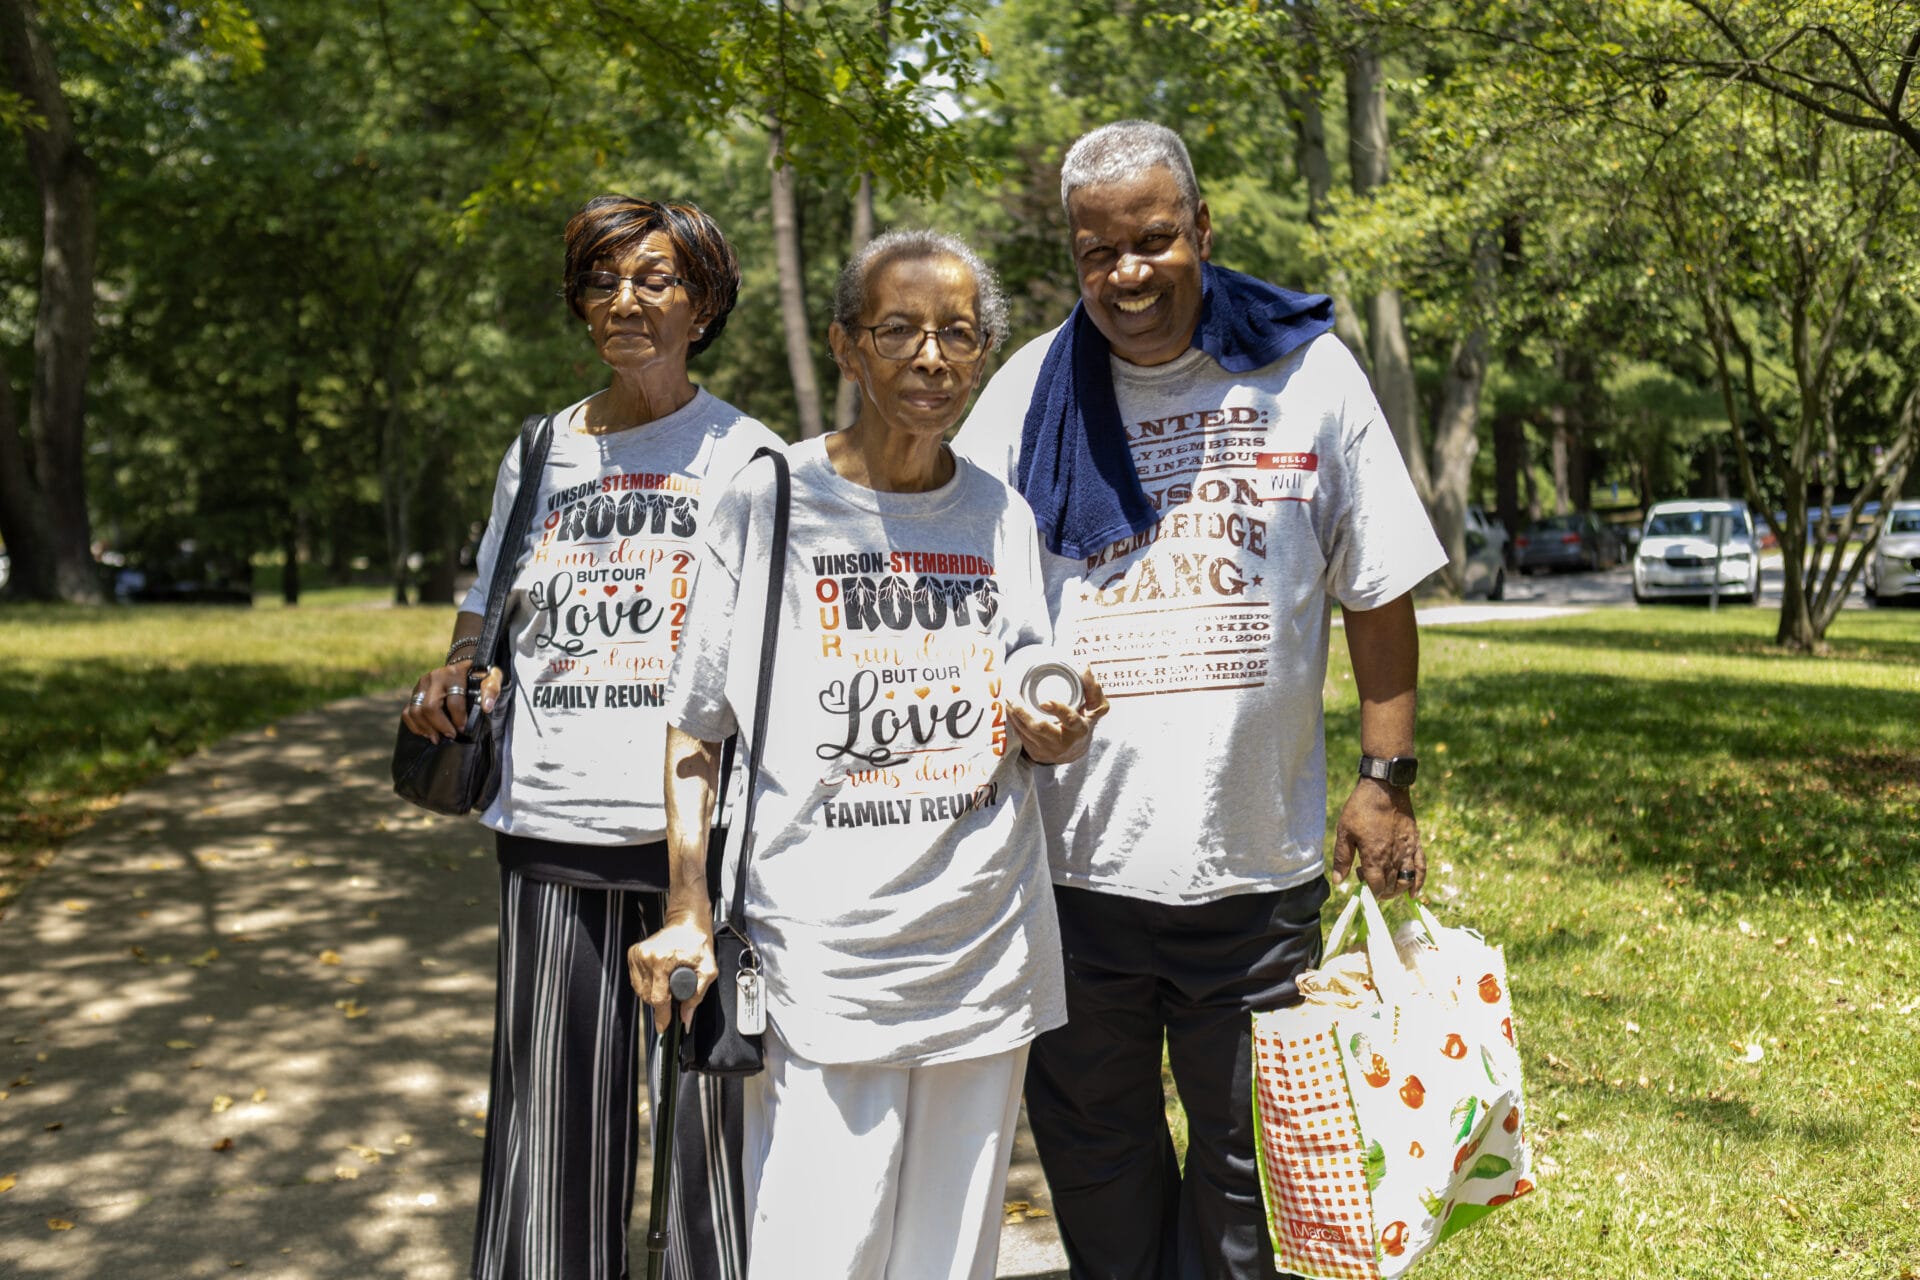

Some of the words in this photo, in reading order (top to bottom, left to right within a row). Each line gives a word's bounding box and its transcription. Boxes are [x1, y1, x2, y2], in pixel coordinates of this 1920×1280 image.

[1158, 437, 1266, 459] MEMBERS
[1272, 456, 1307, 464] HELLO
[1142, 478, 1263, 512] NSON
[1272, 473, 1302, 491] Will
[557, 491, 699, 541] ROOTS
[577, 570, 609, 583] BUT
[612, 567, 646, 582] OUR
[1095, 552, 1249, 607] GANG
[529, 571, 665, 658] Love
[670, 553, 690, 652] 2025
[815, 578, 844, 658] OUR
[842, 575, 1001, 632] ROOTS
[882, 668, 917, 684] BUT
[922, 665, 961, 681] OUR
[1246, 659, 1269, 669] OF
[533, 684, 599, 710] FAMILY
[982, 648, 1008, 757] 2025
[816, 669, 985, 768] Love
[824, 799, 912, 828] FAMILY
